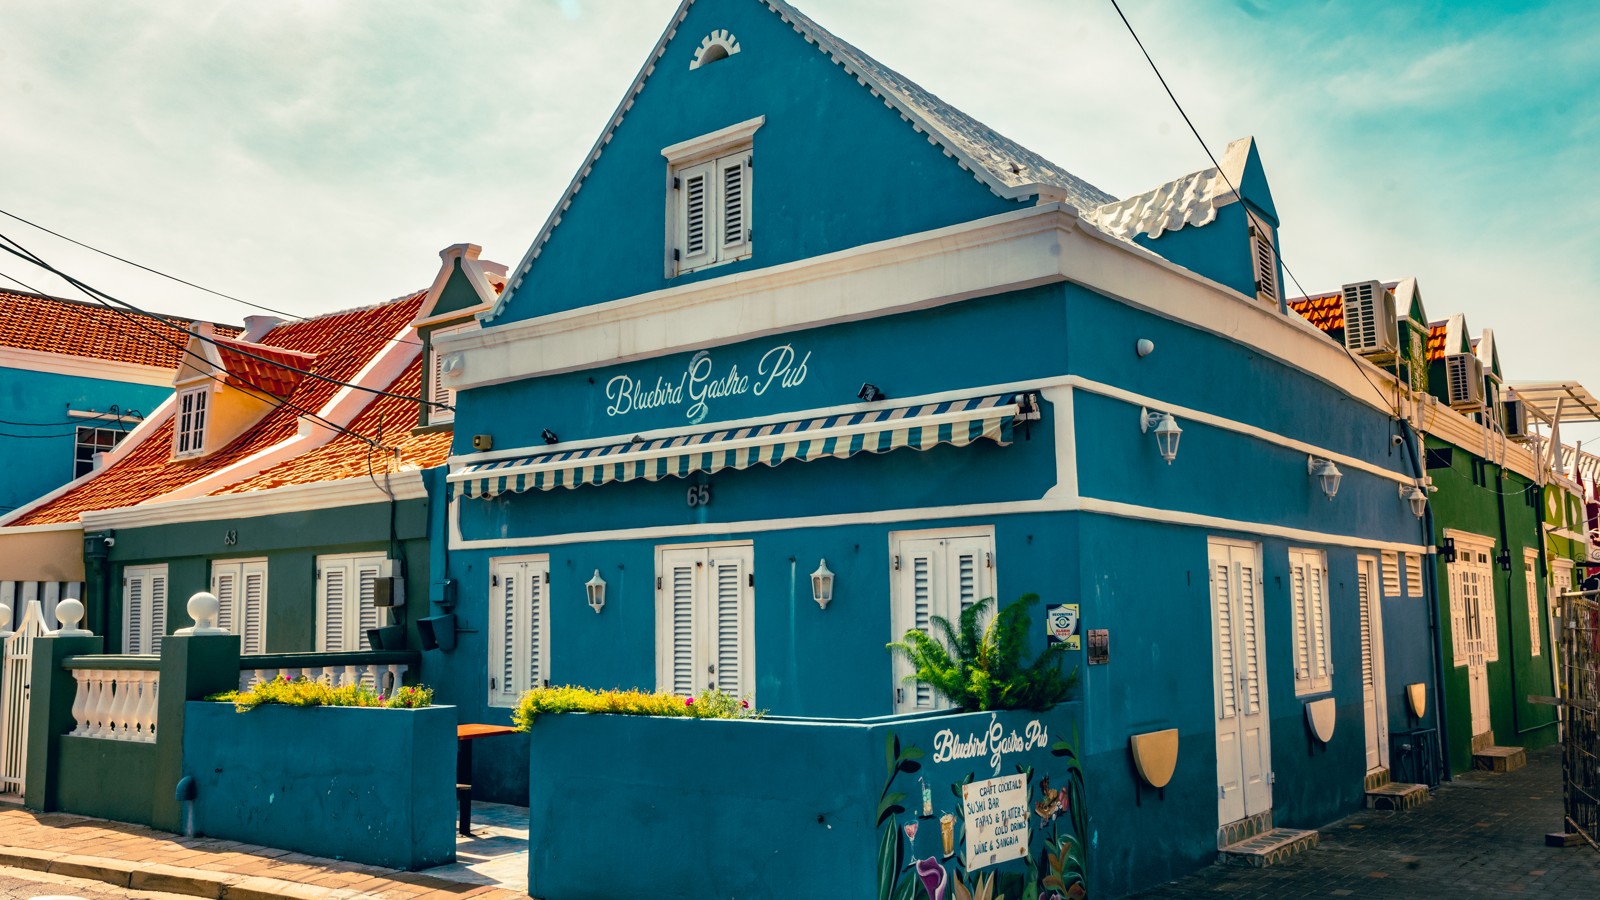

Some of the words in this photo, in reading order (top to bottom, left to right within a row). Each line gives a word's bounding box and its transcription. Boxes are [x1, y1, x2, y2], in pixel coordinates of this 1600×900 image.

[606, 372, 687, 416] Bluebird
[687, 356, 749, 418] Gastro
[754, 343, 811, 396] Pub
[687, 485, 709, 507] 65
[224, 529, 236, 545] 63
[933, 729, 989, 763] Bluebird
[989, 714, 1024, 769] Gastro
[1025, 720, 1048, 751] Pub
[979, 785, 997, 797] CRAFT
[988, 797, 1000, 811] BAR
[975, 814, 993, 828] TAPAS
[995, 824, 1008, 836] COLD
